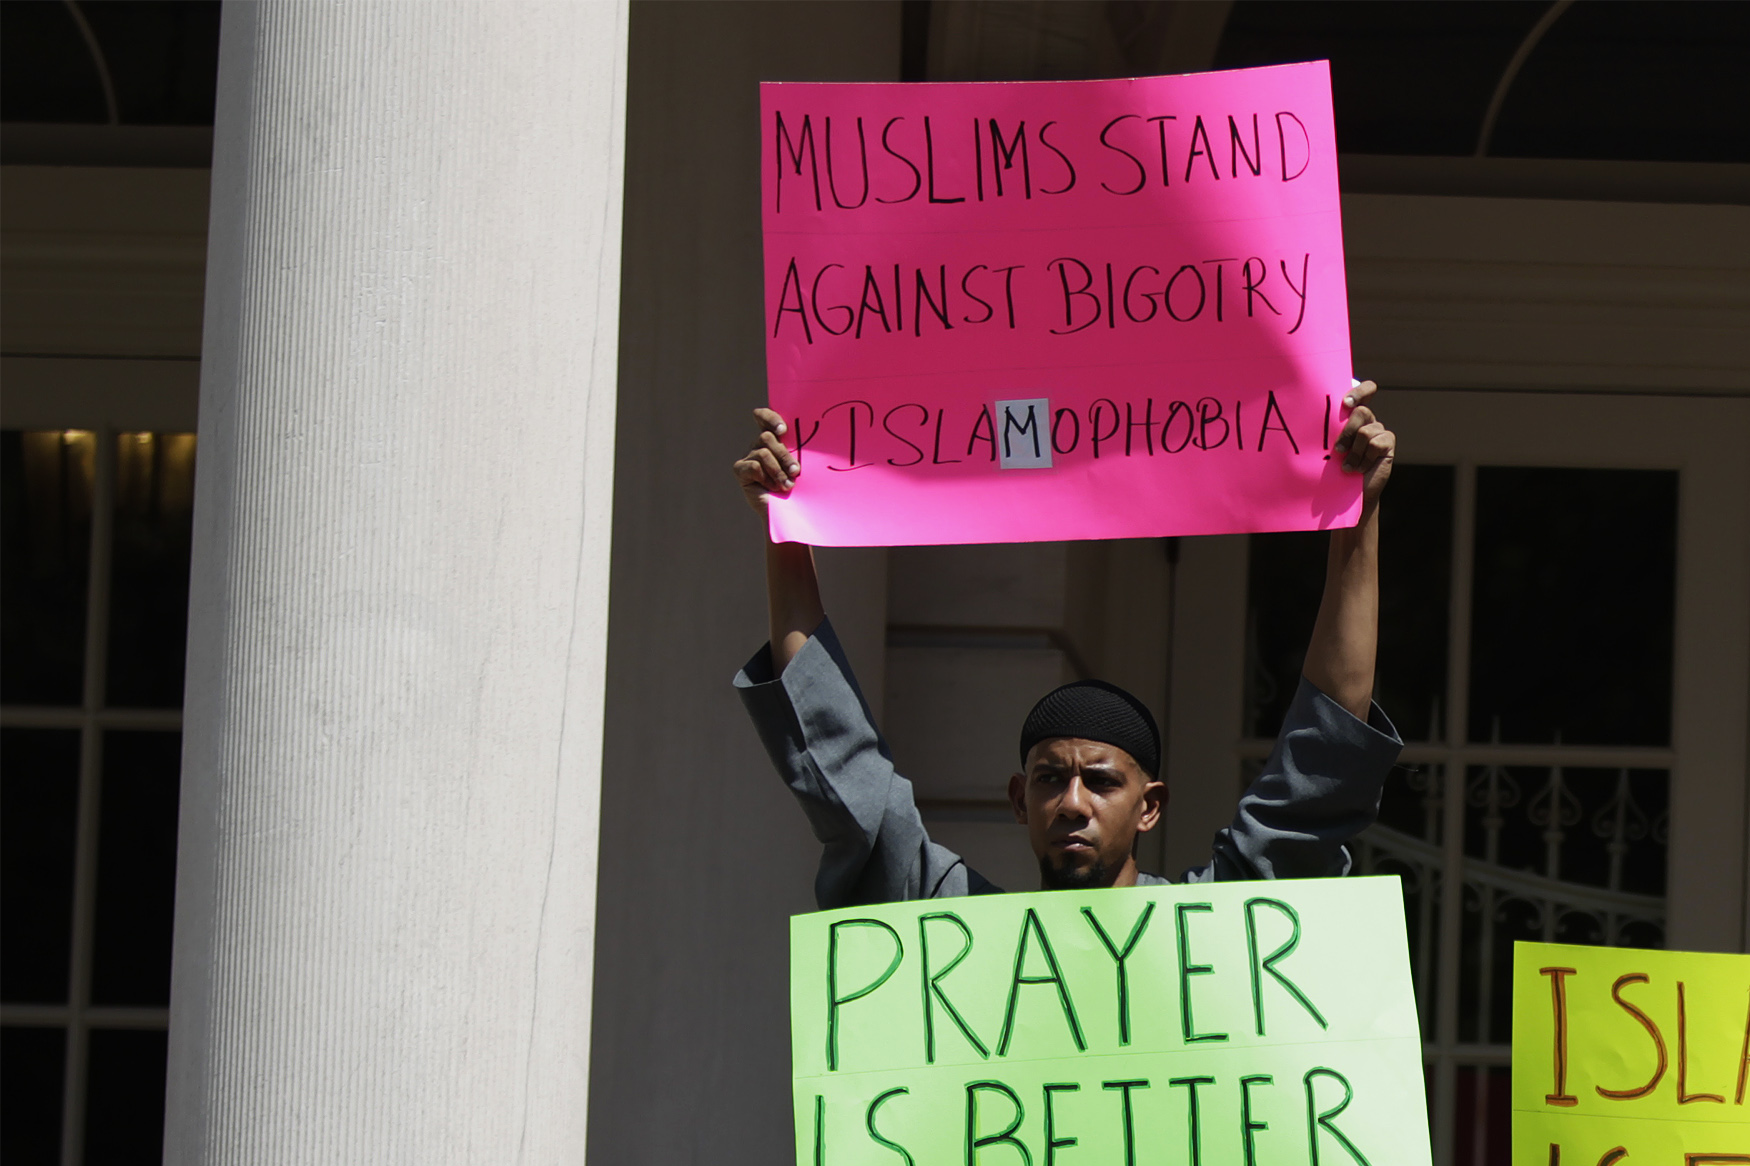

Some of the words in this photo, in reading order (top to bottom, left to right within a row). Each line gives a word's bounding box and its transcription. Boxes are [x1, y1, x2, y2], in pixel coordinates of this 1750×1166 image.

[775, 110, 1077, 213] MUSLIMS
[1100, 110, 1310, 197] STAND
[773, 256, 1027, 345] AGAINST
[1047, 251, 1310, 335] BIGOTRY
[827, 897, 1328, 1071] PRAYER
